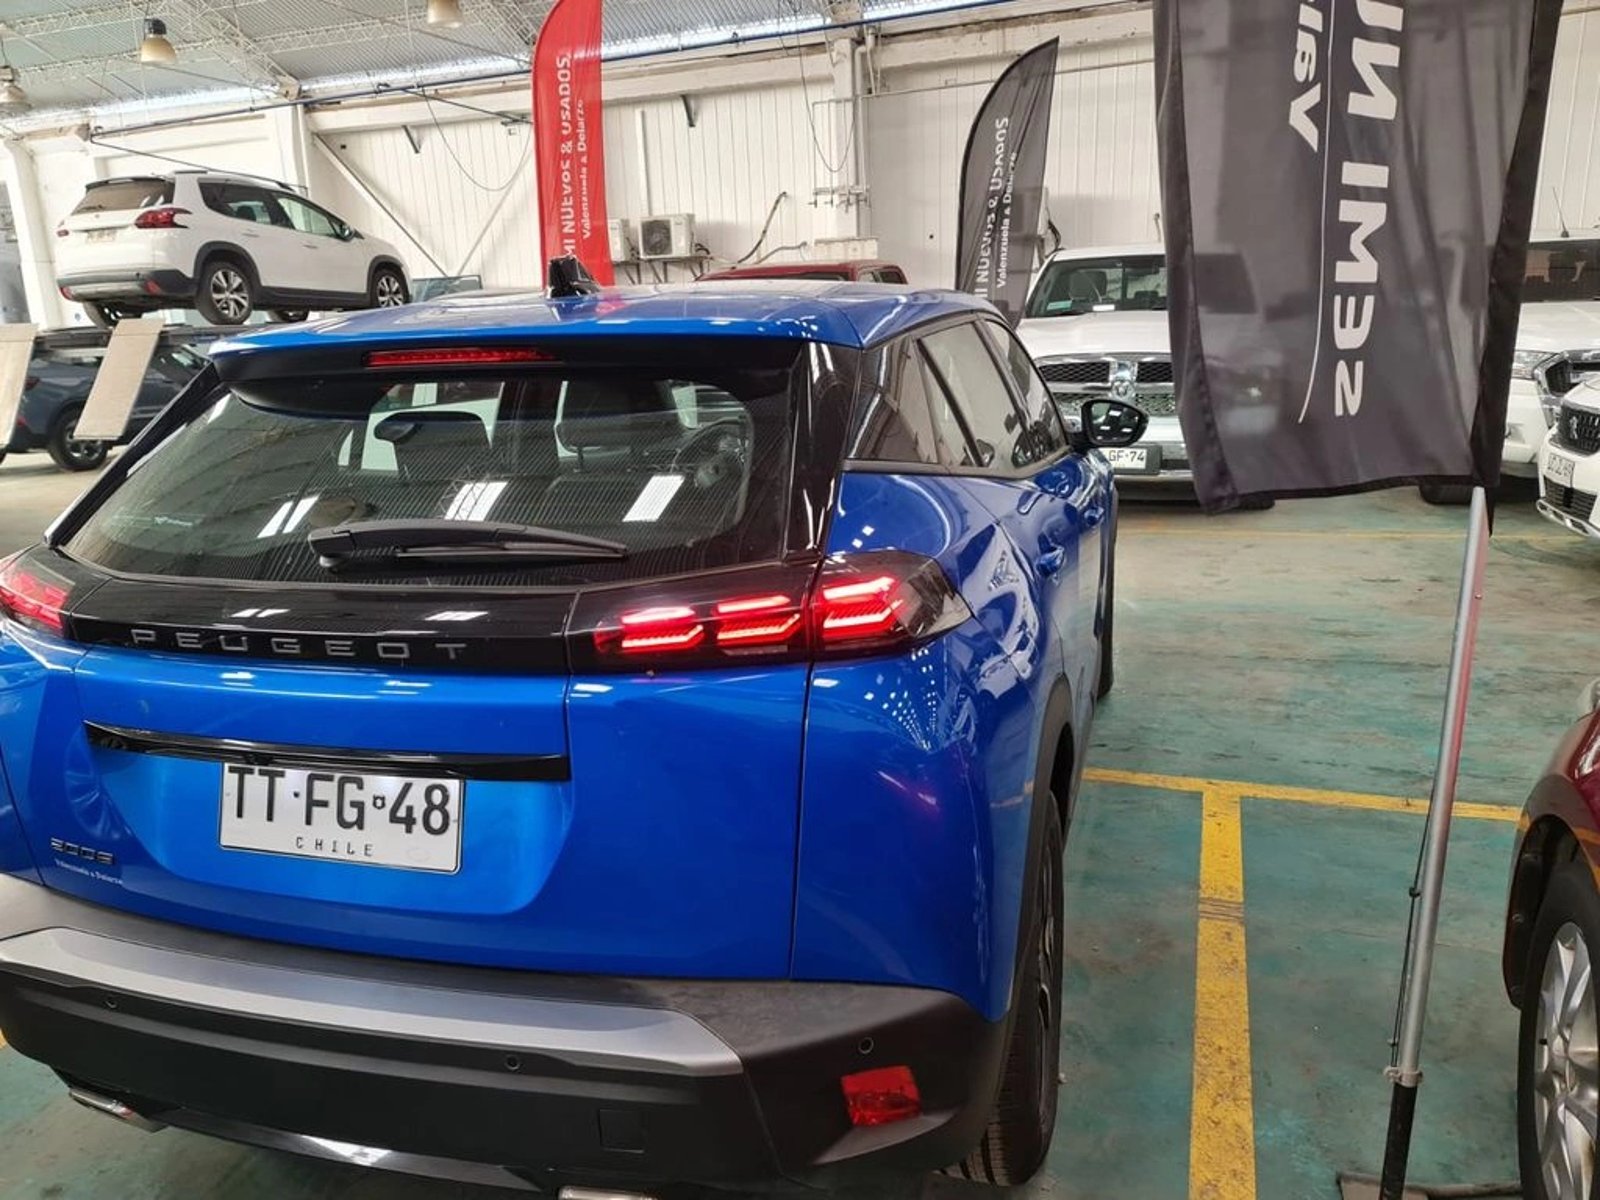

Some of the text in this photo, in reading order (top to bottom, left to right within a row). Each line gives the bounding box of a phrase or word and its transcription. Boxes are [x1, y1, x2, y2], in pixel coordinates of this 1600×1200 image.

[556, 56, 572, 135] USADOS
[560, 160, 576, 234] NUEVOS
[997, 218, 1011, 288] Valenzuela
[131, 629, 467, 660] PEUGEOT
[295, 836, 373, 858] CHILE
